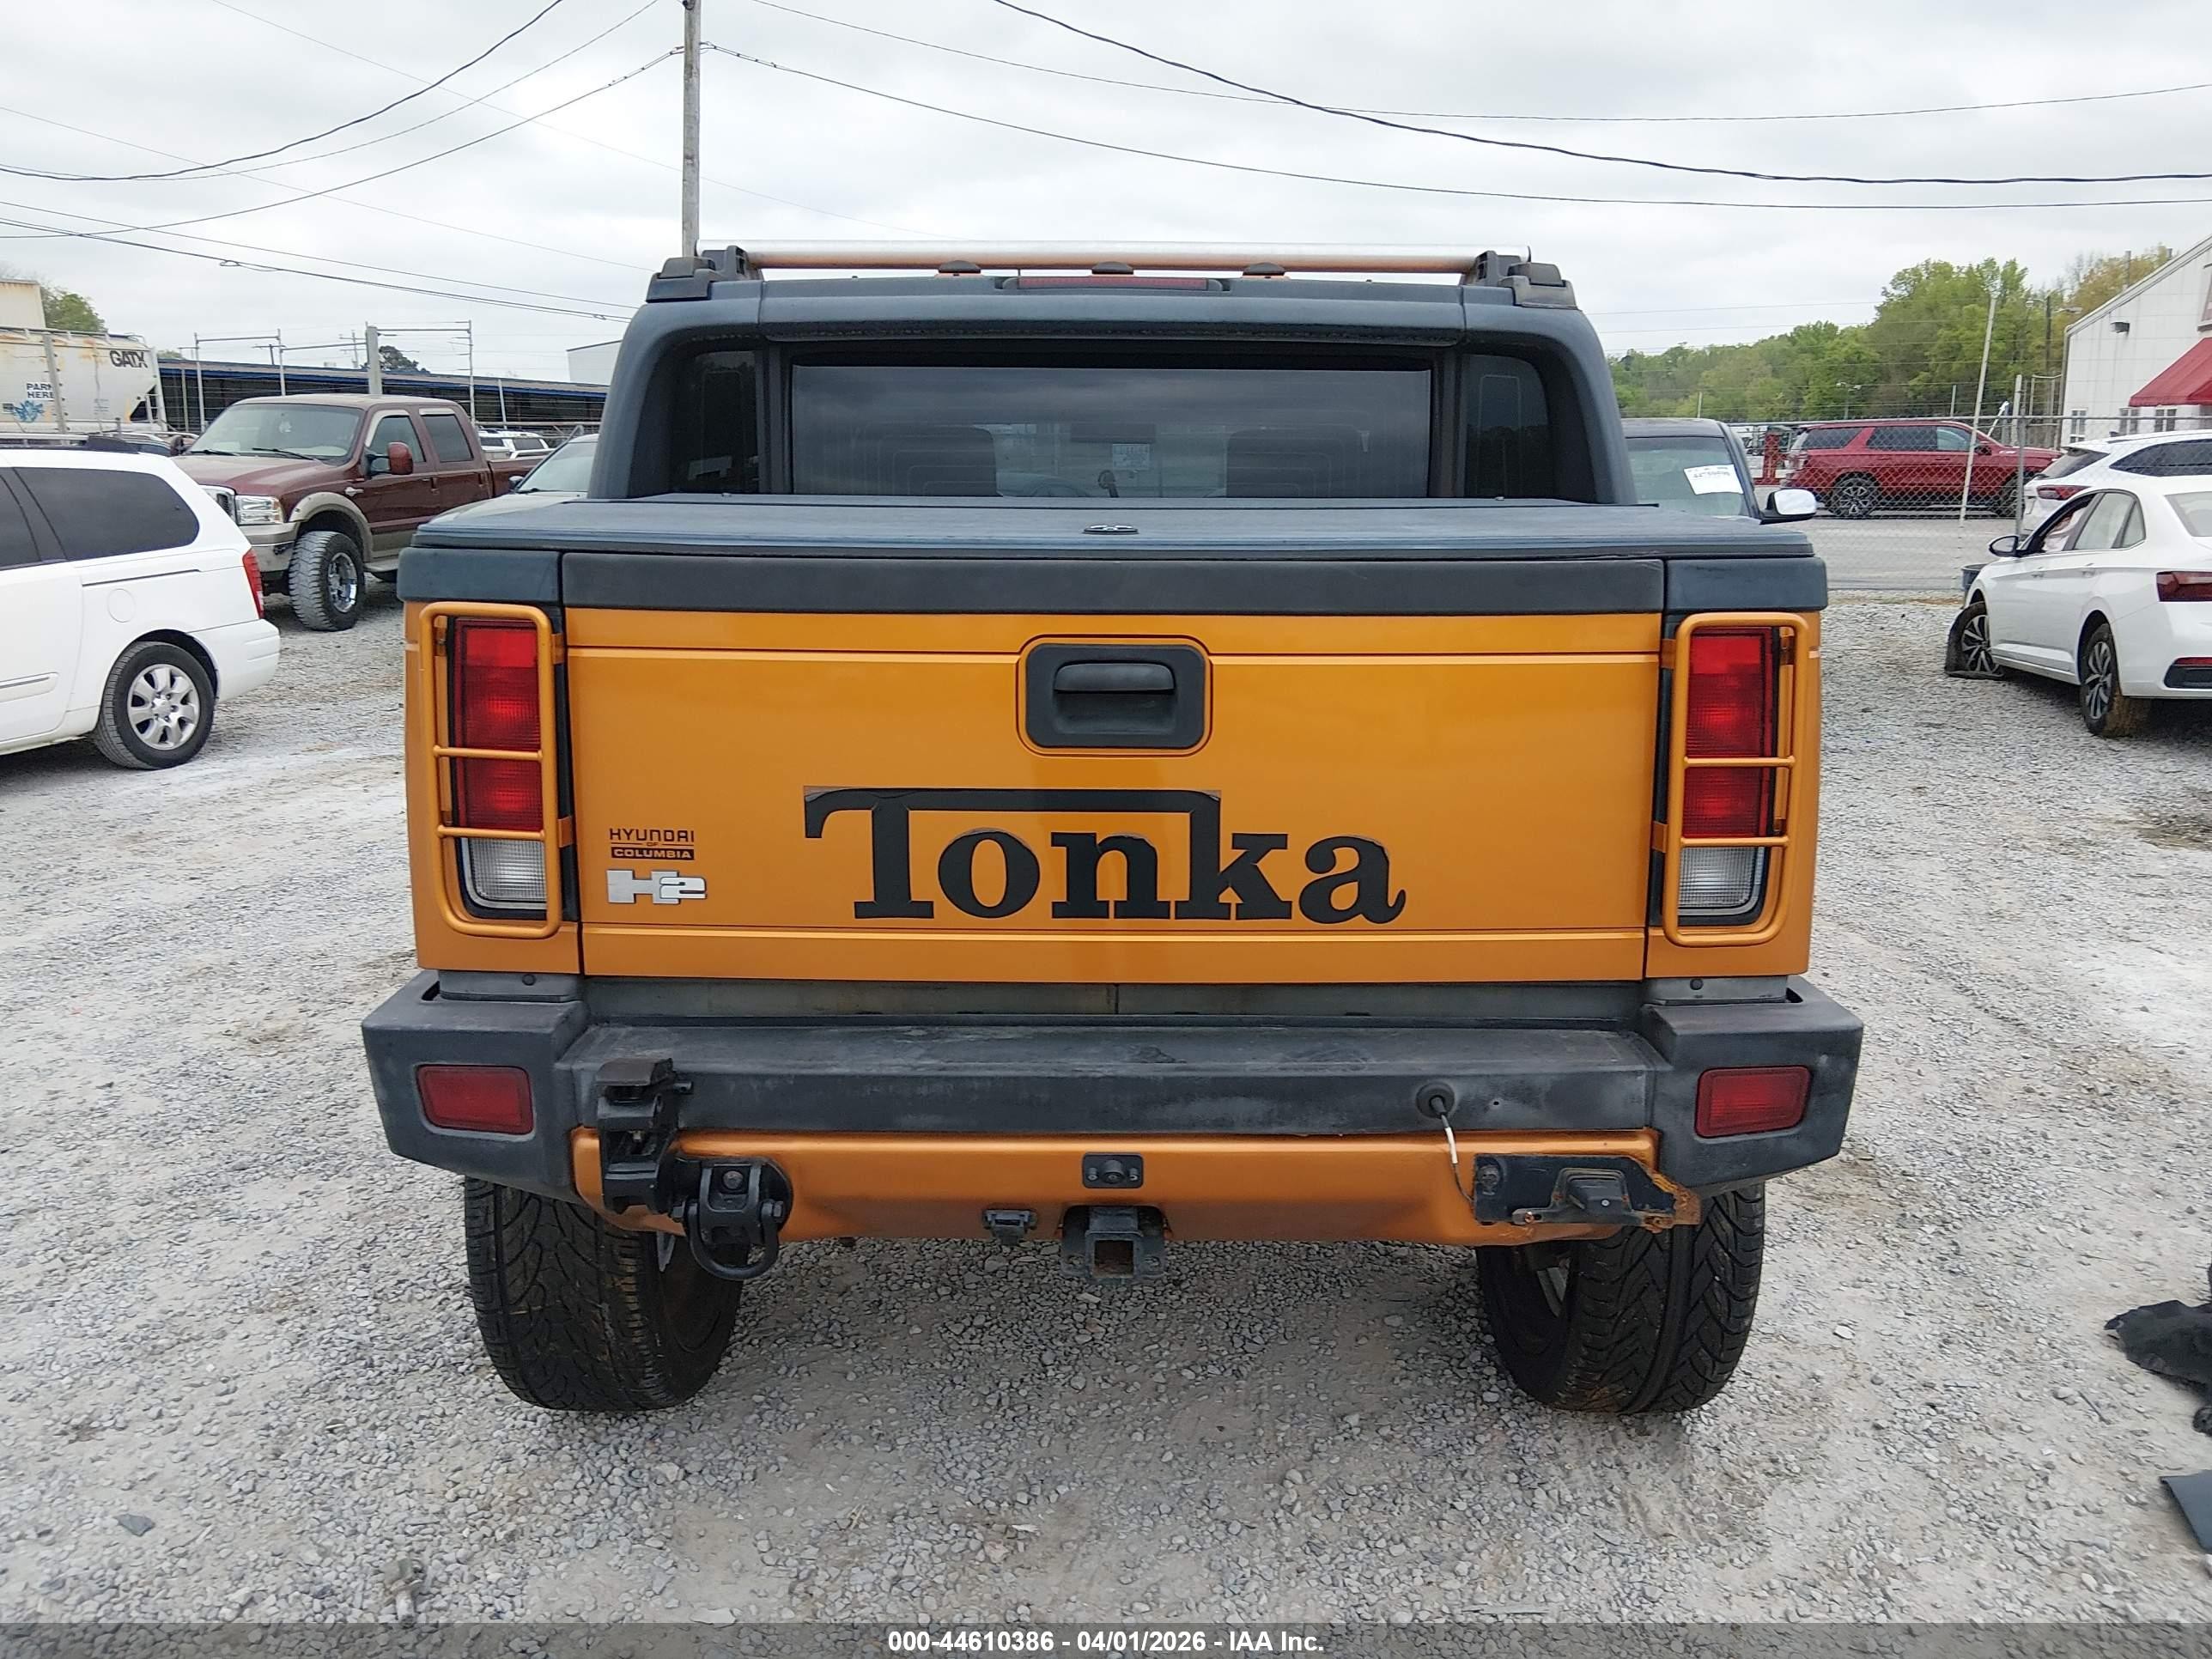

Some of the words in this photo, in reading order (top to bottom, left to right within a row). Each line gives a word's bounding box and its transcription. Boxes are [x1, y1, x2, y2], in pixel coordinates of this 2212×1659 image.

[110, 349, 149, 368] GATX
[609, 828, 695, 842] HYUNDAI
[613, 848, 692, 859] COLUMBIA
[804, 786, 1407, 925] Tonka
[606, 868, 708, 904] H2
